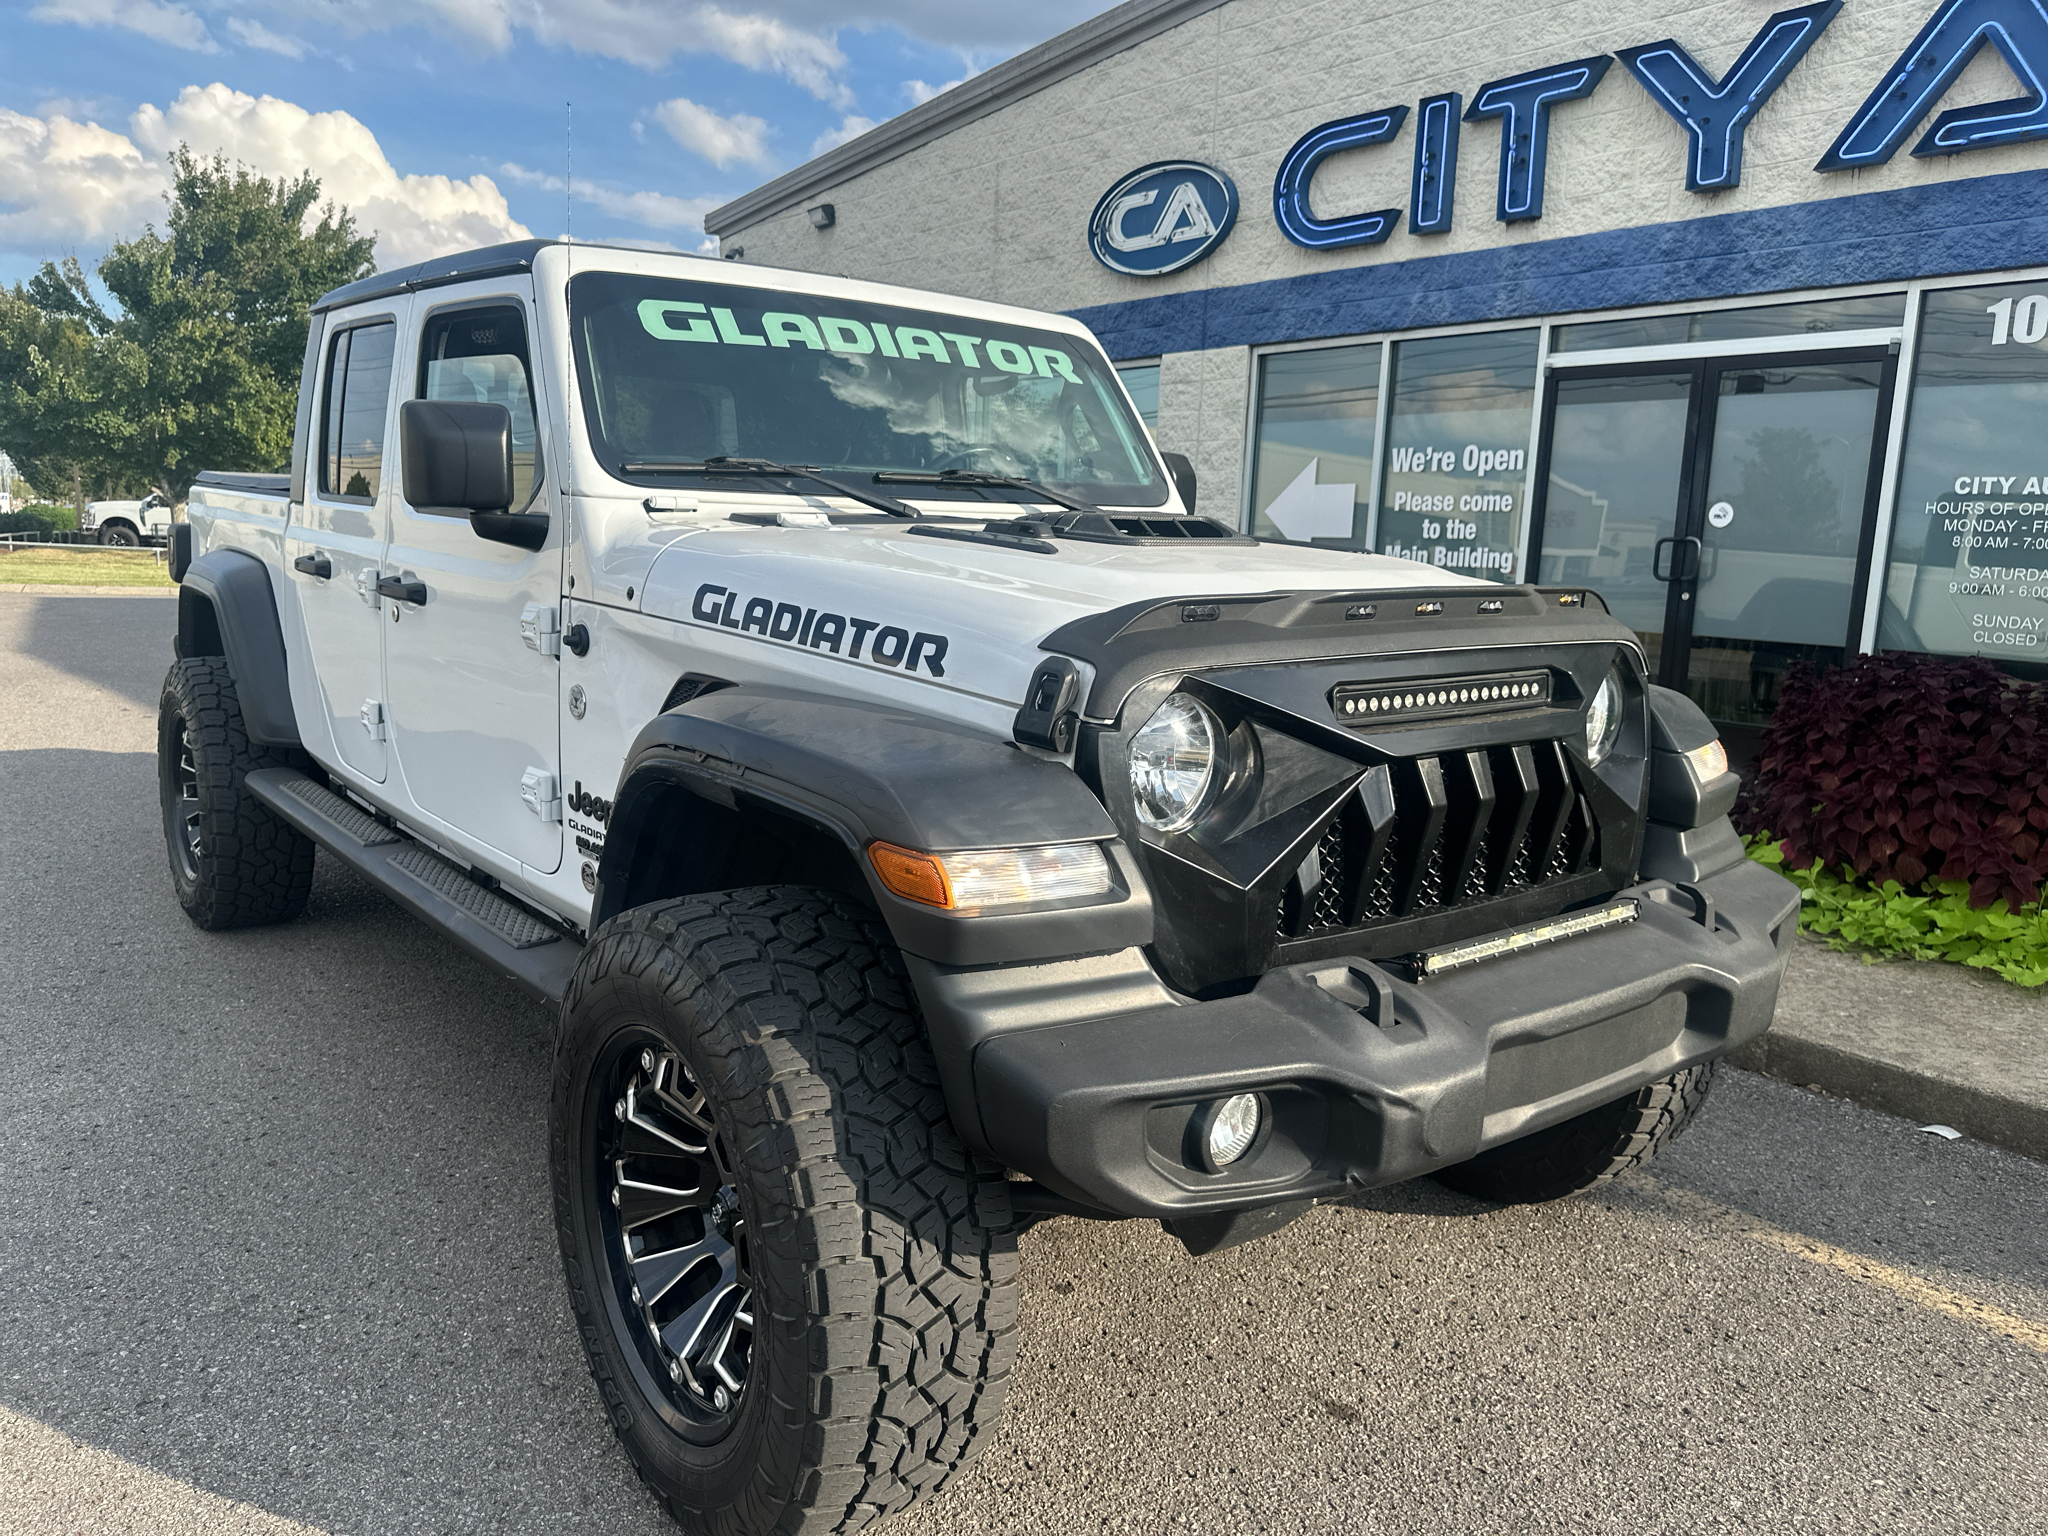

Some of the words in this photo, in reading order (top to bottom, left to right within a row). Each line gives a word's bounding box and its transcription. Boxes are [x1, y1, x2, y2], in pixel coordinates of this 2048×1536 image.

[1273, 0, 1845, 251] CITY
[1106, 182, 1216, 252] CA
[1986, 294, 2048, 345] 10
[637, 299, 1084, 385] GLADIATOR
[1392, 446, 1456, 473] We're
[1462, 444, 1525, 477] Open
[1954, 476, 2017, 495] CITY
[1394, 491, 1454, 512] Please
[1459, 493, 1513, 512] come
[1925, 501, 1985, 515] HOURS
[1989, 502, 2015, 516] OF
[1422, 518, 1441, 540] to
[1446, 518, 1477, 540] the
[1943, 518, 2018, 533] MONDAY
[1952, 535, 1982, 548] 8:00
[1984, 536, 2009, 549] AM
[1434, 546, 1513, 574] Building
[1949, 582, 1979, 594] 9:00
[1981, 584, 2005, 596] AM
[692, 583, 949, 678] GLADIATOR
[1972, 613, 2045, 631] SUNDAY
[1973, 630, 2038, 646] CLOSED
[583, 1325, 634, 1432] OPEN
